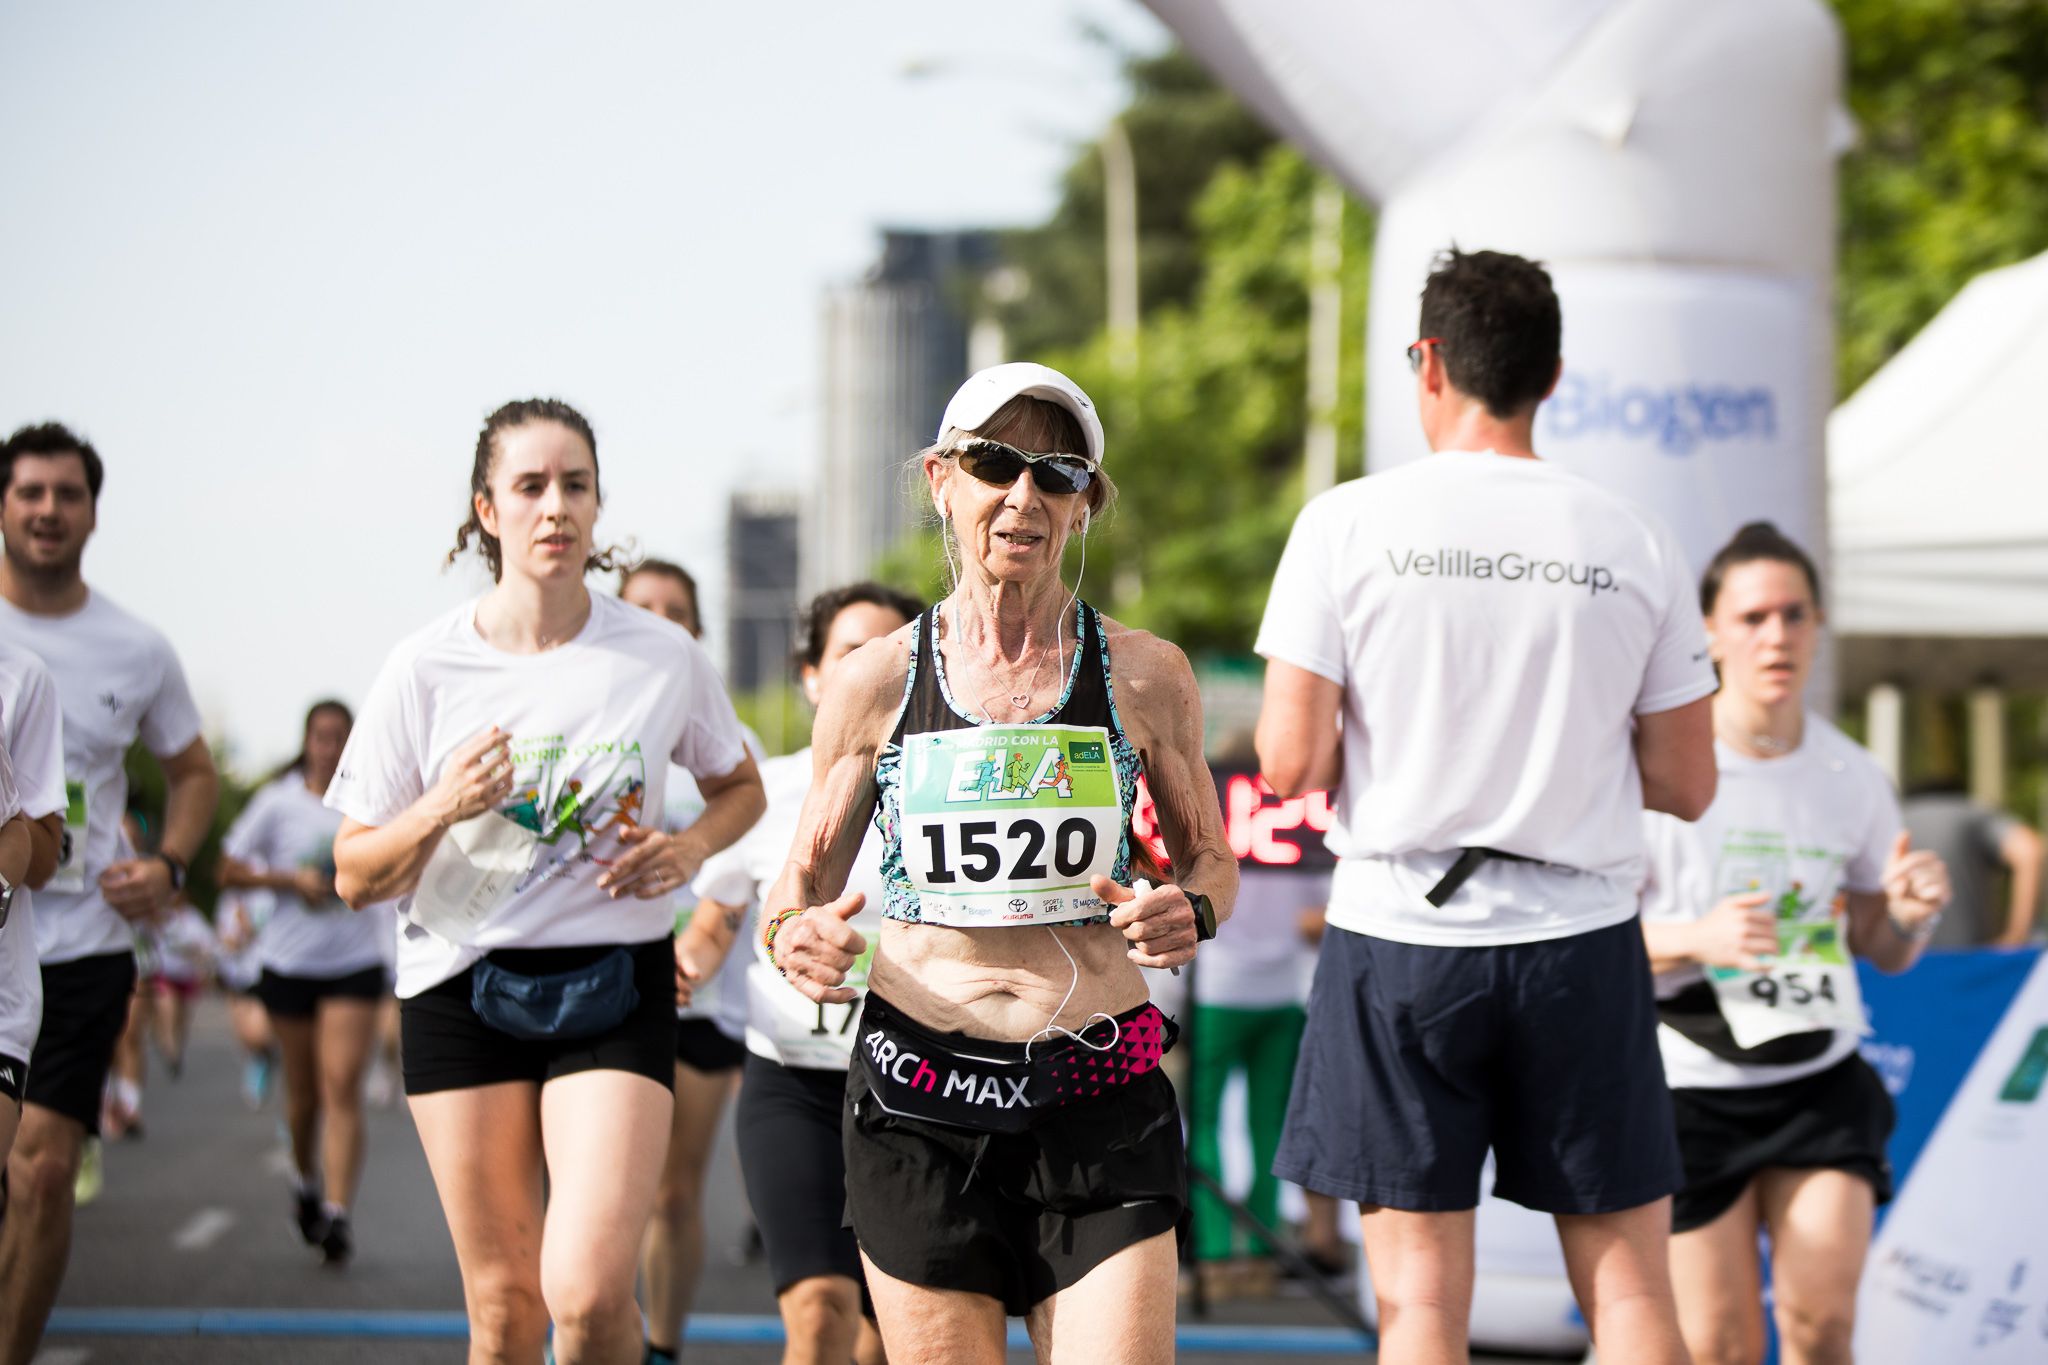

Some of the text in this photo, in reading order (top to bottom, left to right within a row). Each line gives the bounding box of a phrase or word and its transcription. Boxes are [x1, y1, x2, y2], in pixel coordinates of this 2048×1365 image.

[1548, 374, 1777, 456] Biogen
[1387, 549, 1619, 596] VelillaGroup.
[511, 744, 568, 764] ADRID
[1011, 735, 1040, 746] CON
[1042, 735, 1059, 745] LA
[1073, 751, 1101, 760] adELA
[945, 748, 1073, 803] ELA
[922, 817, 1097, 883] 1520
[1045, 904, 1058, 912] LIFE
[942, 1069, 1032, 1109] MAX
